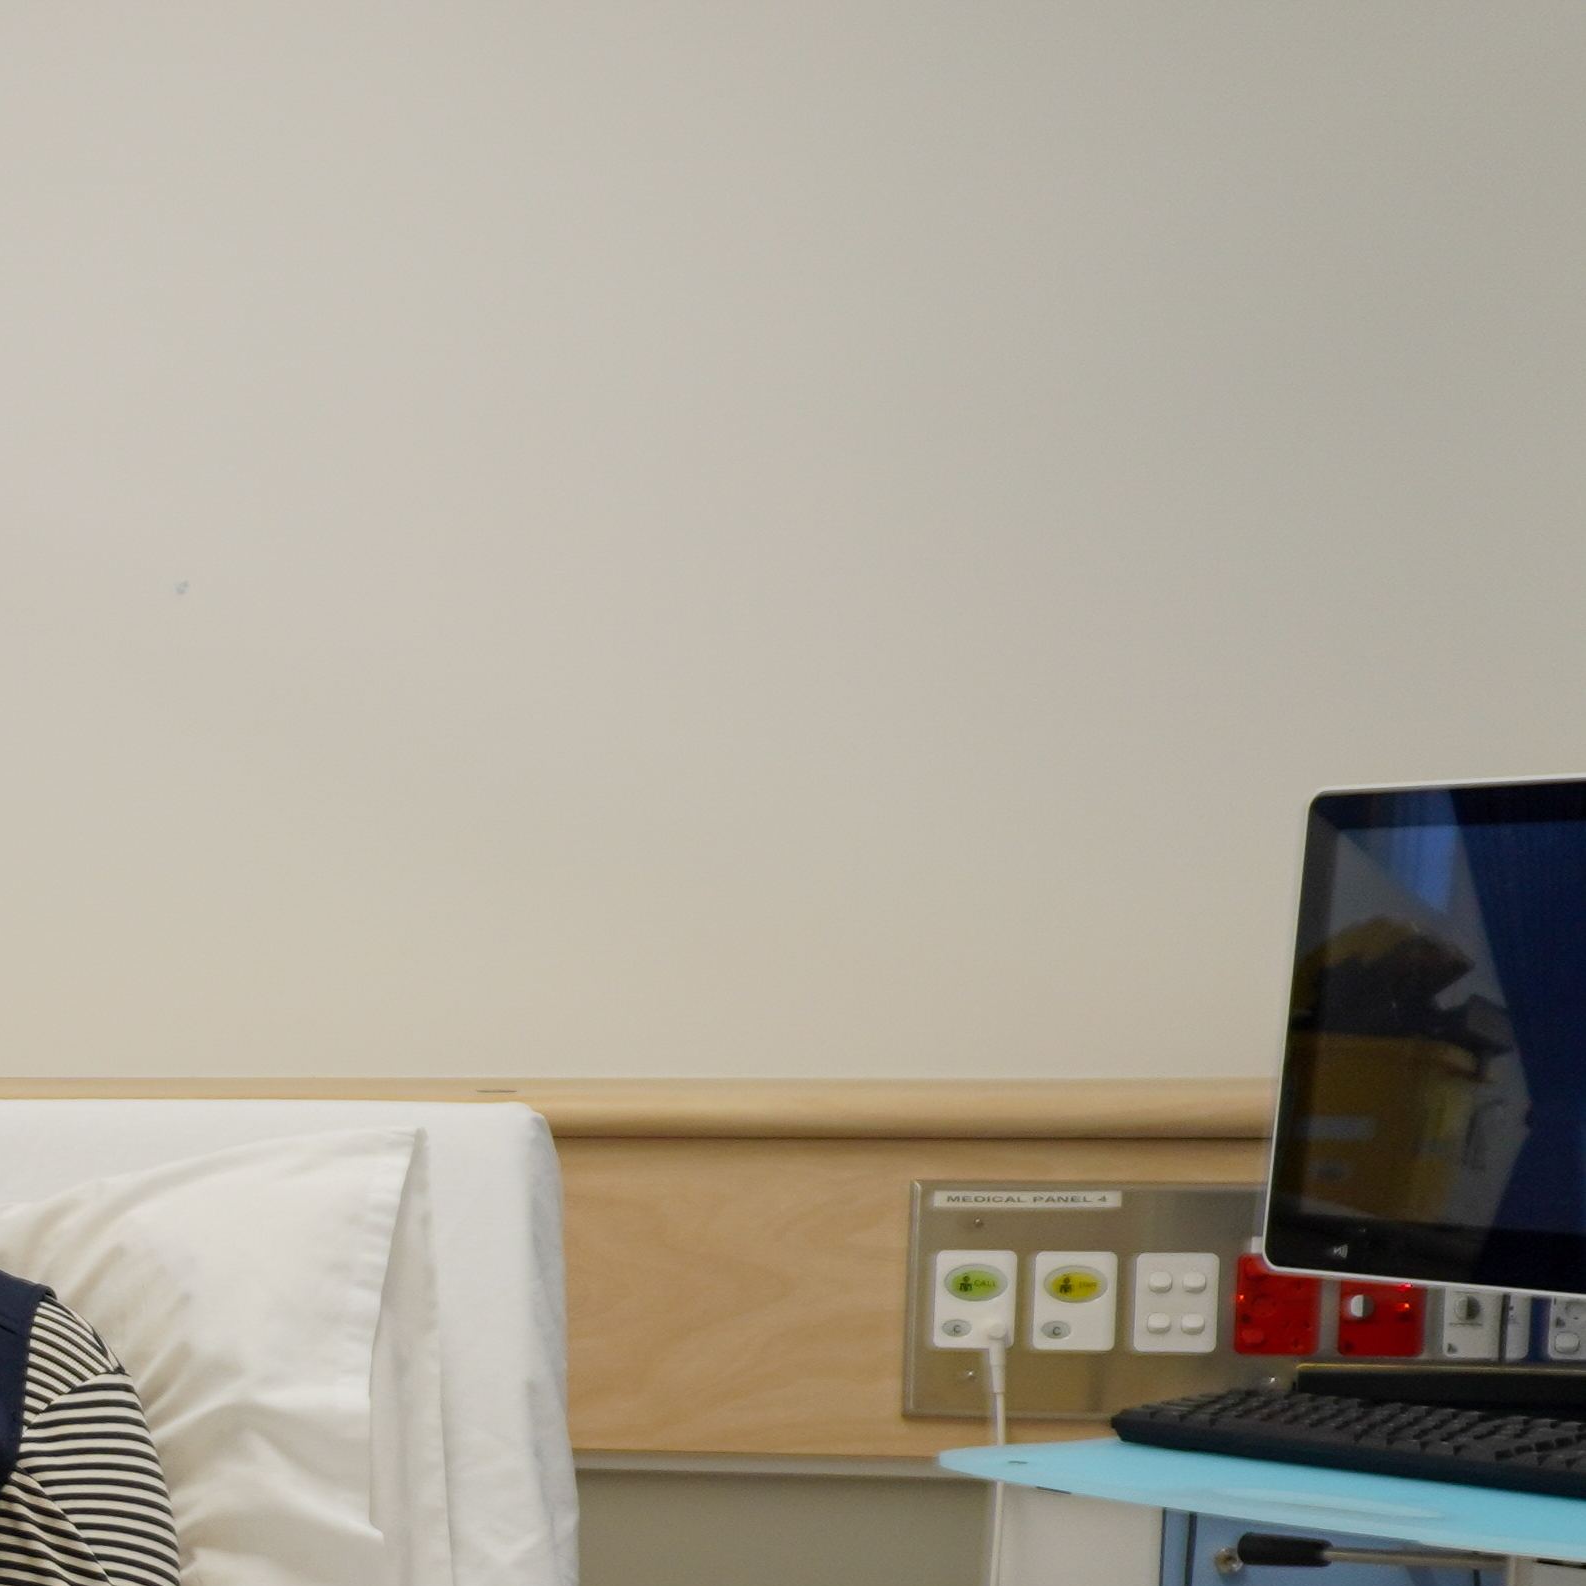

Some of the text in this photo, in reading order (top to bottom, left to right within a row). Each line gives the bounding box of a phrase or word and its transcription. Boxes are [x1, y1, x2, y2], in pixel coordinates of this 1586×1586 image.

[946, 1195, 1108, 1203] MEDICAL PANEL 4
[973, 1279, 997, 1288] CALL
[953, 1324, 961, 1333] C
[1052, 1326, 1061, 1336] C
